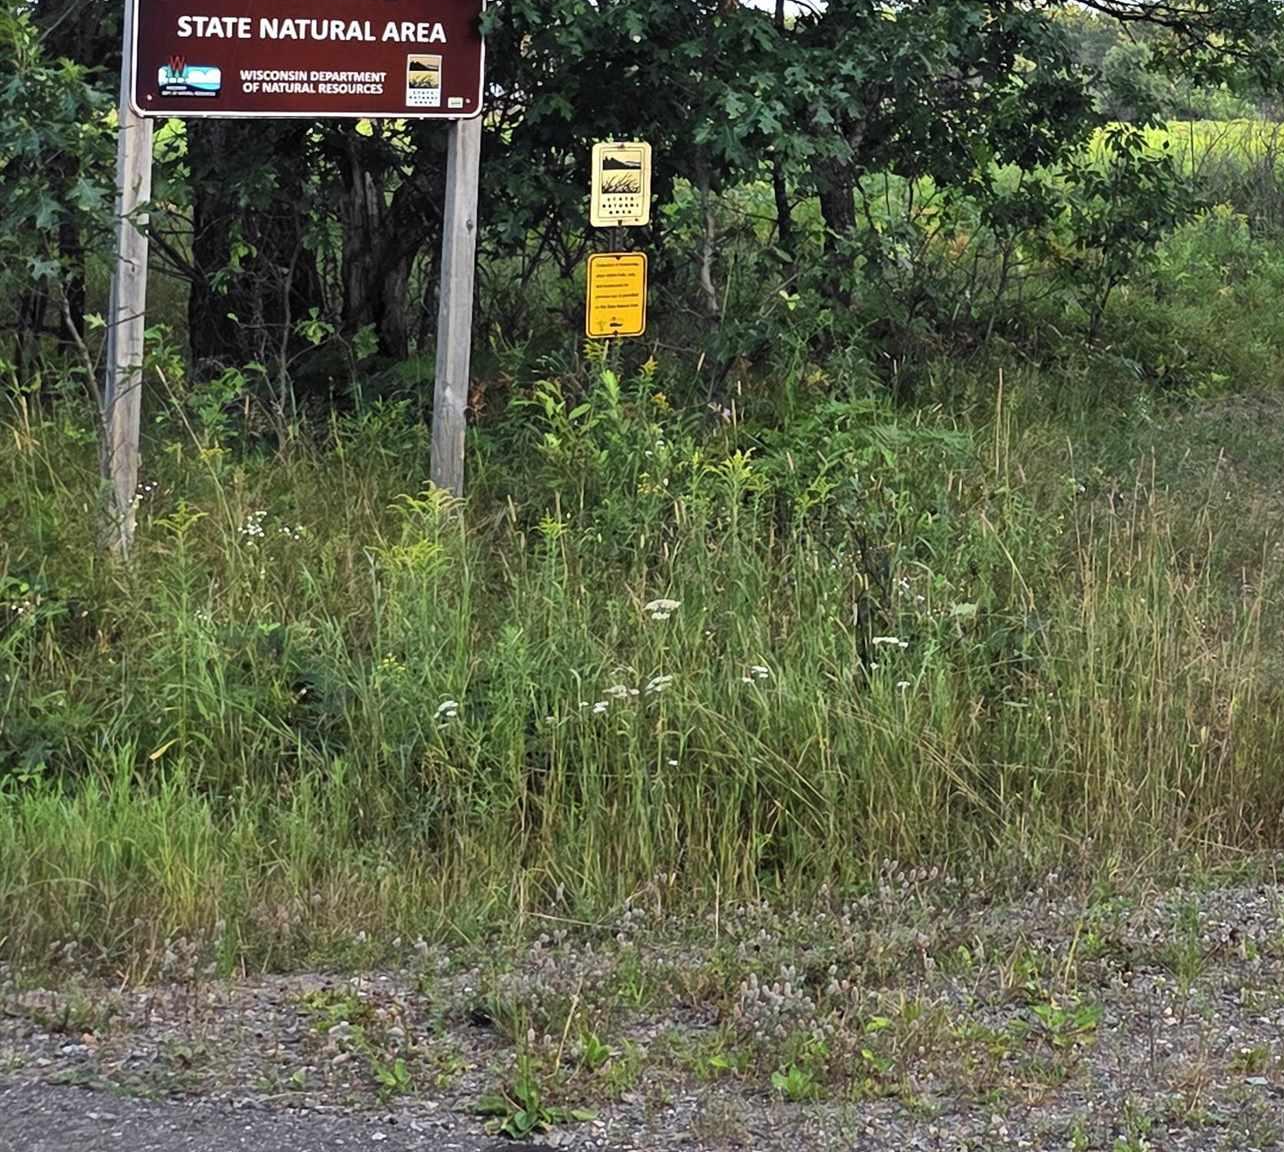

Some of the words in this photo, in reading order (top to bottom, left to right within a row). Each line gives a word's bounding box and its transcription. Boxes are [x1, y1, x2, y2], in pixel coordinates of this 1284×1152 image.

[177, 16, 252, 39] STATE
[259, 18, 376, 42] NATURAL
[382, 22, 447, 44] AREA
[240, 70, 307, 82] WISCONSIN
[310, 71, 387, 83] DEPARTMENT
[243, 82, 259, 93] OF
[262, 82, 316, 94] NATURAL
[318, 83, 384, 95] RESOURCES
